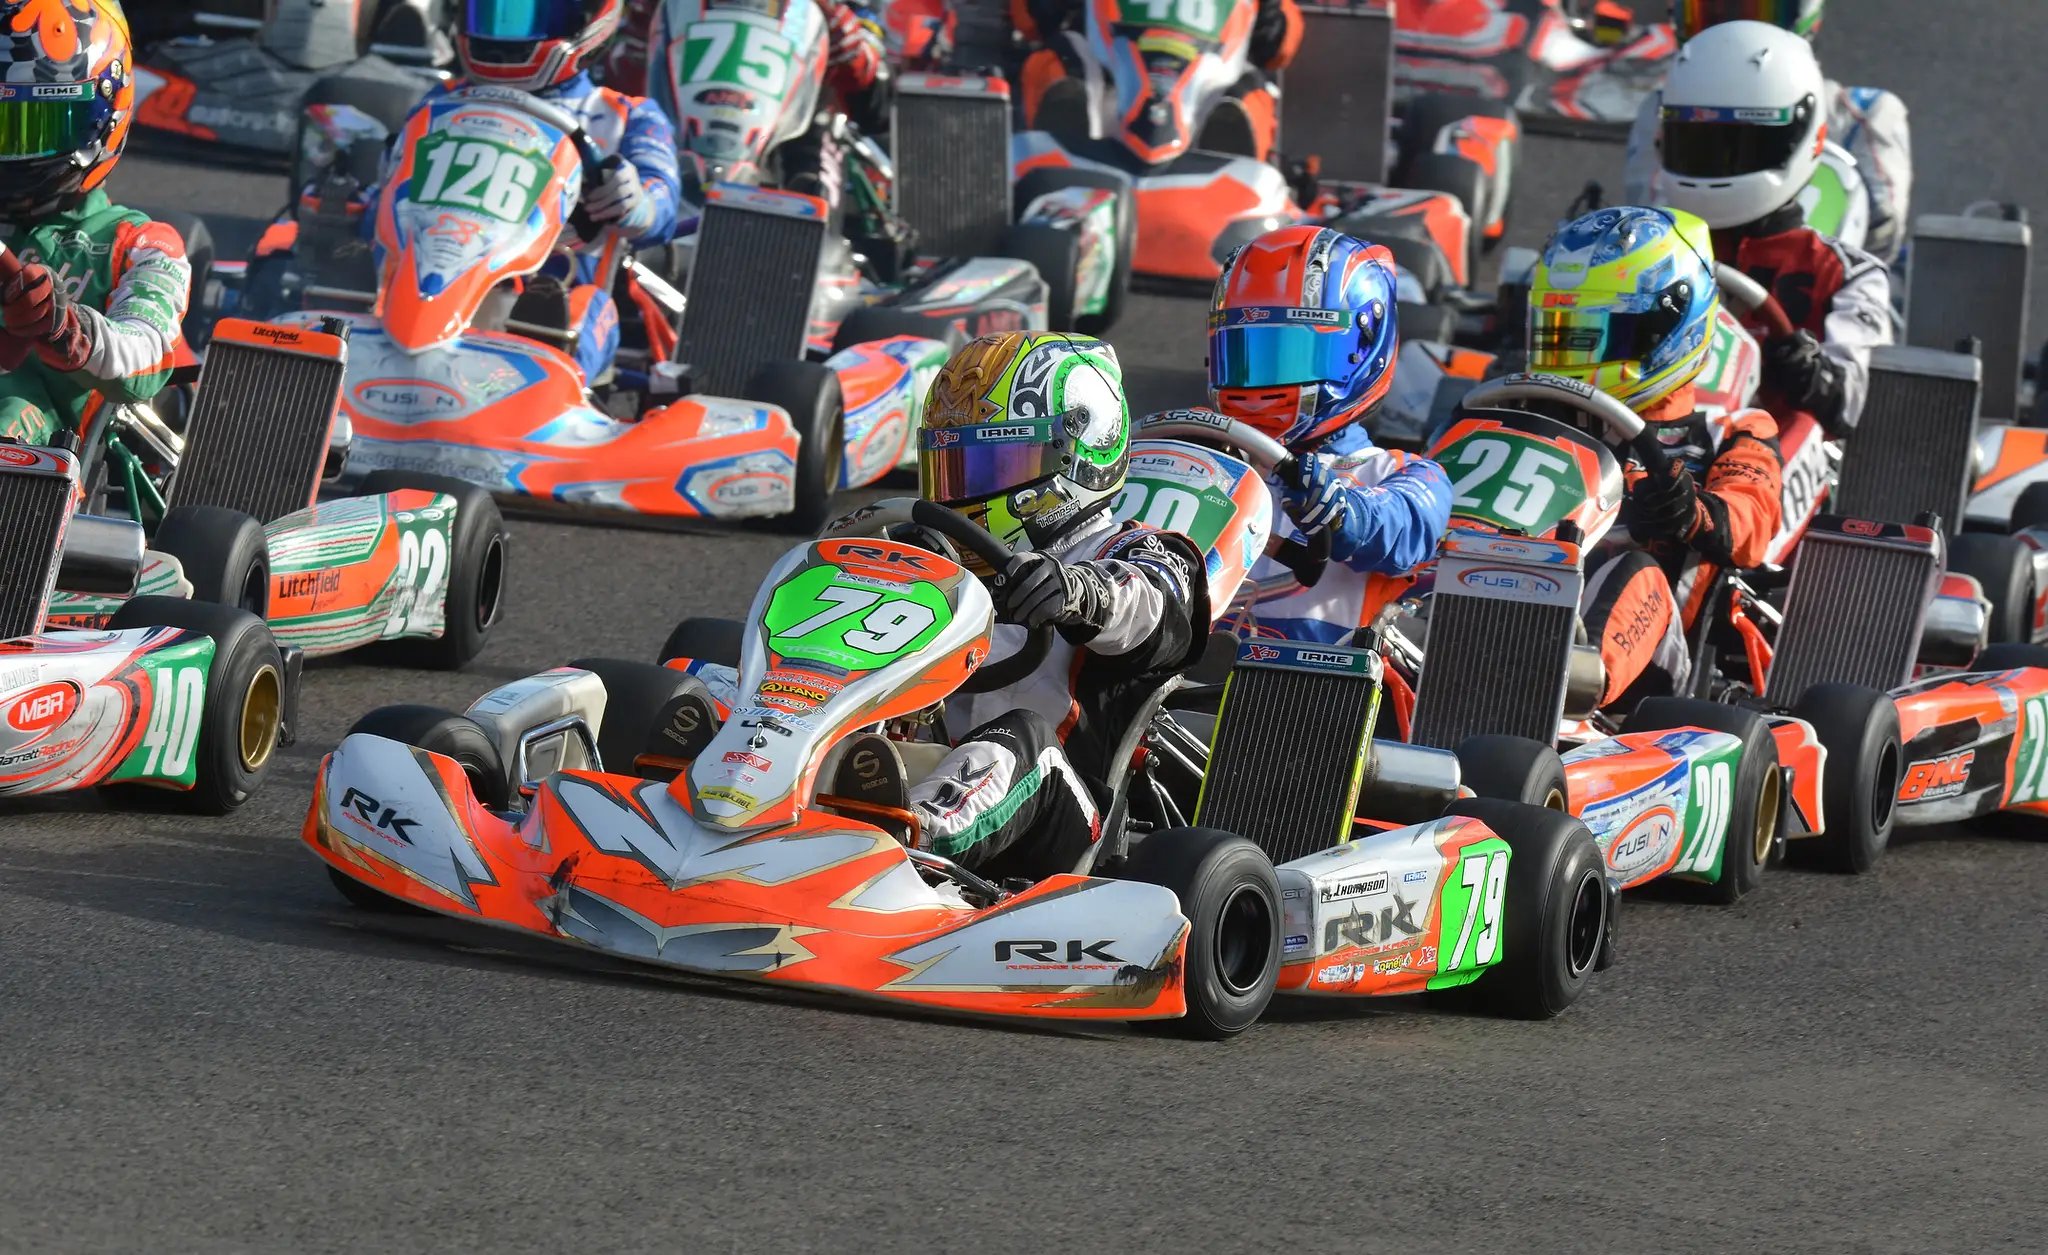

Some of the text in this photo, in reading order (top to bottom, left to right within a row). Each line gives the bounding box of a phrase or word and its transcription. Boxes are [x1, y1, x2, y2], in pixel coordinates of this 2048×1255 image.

[688, 22, 791, 95] 75
[38, 86, 79, 95] IAME
[418, 141, 537, 223] 126
[1238, 308, 1270, 323] X30
[1292, 310, 1335, 320] IAME
[253, 326, 300, 343] Litchfield
[1509, 373, 1592, 396] EXPRIT
[1144, 411, 1229, 426] EXPRIT
[932, 430, 960, 449] X30
[981, 427, 1030, 437] IAME
[1129, 456, 1205, 475] FUSION
[1453, 438, 1569, 527] 25
[836, 544, 937, 575] RK
[279, 569, 341, 611] Litchfield
[1468, 572, 1551, 592] FUSION
[772, 585, 937, 655] 79
[1243, 645, 1280, 660] X30
[1302, 652, 1348, 663] IAME
[760, 682, 826, 702] ALFANO
[142, 667, 204, 776] 40
[861, 776, 888, 791] sparco
[340, 786, 423, 846] RK
[1671, 762, 1730, 874] 20
[1615, 821, 1670, 861] FUSION
[1447, 850, 1508, 972] 79
[1325, 894, 1431, 953] RK
[994, 939, 1128, 963] RK
